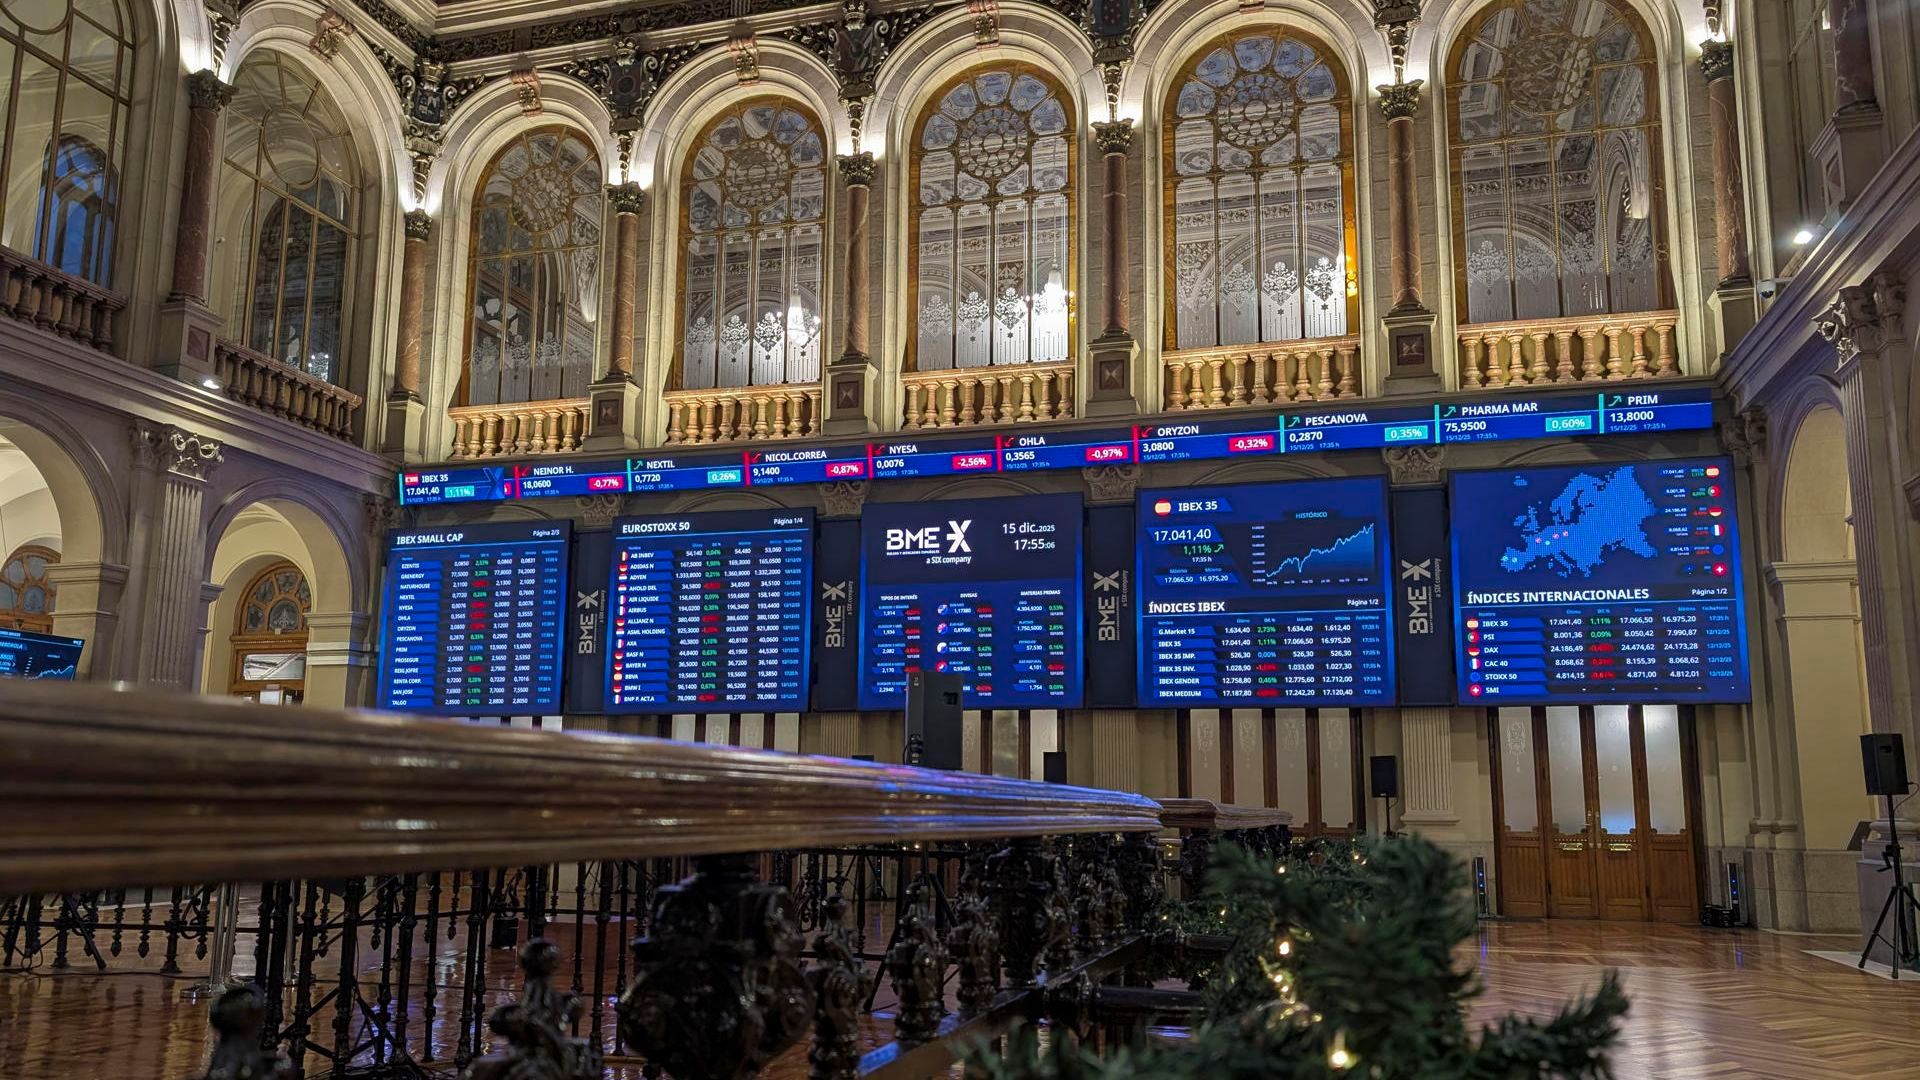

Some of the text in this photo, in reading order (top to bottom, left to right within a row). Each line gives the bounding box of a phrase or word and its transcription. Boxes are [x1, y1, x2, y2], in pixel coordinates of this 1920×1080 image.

[1628, 395, 1658, 405] PRIM
[1462, 403, 1537, 416] PHARMA MAR
[1305, 414, 1367, 426] PESCANOVA
[1610, 411, 1654, 422] 13,8000
[1157, 425, 1199, 436] ORYZON
[1445, 419, 1585, 433] 75,9500 0,60%
[1289, 429, 1422, 442] 0,2870 0,35%
[1019, 437, 1045, 446] OHLA
[1143, 439, 1268, 452] 3,0800 -0,32%
[889, 445, 918, 454] NYESA
[1006, 449, 1122, 461] 0,3565 -0,97%
[765, 451, 827, 462] NICOL.CORREA
[647, 460, 675, 469] NEXTIL
[876, 457, 987, 469] 0,0076 -2,56%
[533, 466, 574, 476] NEINOR H.
[753, 465, 858, 476] 9,1400 -0,87%
[422, 474, 448, 483] IBEX 35
[635, 473, 736, 482] 0,7720 0,26%
[523, 479, 619, 488] 18,0600 -0,77%
[406, 488, 439, 496] 17.041,40
[1179, 501, 1217, 511] IBEX 35
[1296, 511, 1328, 519] HISTÓRICO
[622, 522, 690, 533] EUROSTOXX 50
[1003, 523, 1055, 534] 15 dic.2025
[397, 534, 463, 544] IBEX SMALL CAP
[887, 527, 940, 550] BME
[1154, 529, 1212, 541] 17.041,40
[1014, 539, 1055, 550] 17:55:06
[1184, 545, 1212, 555] 1,11%
[943, 555, 971, 564] company
[1164, 576, 1193, 584] 17.066,50
[1467, 589, 1649, 604] ÍNDICES INTERNACIONALES
[1692, 587, 1727, 597] Página 1/2
[1149, 601, 1224, 614] ÍNDICES IBEX
[1408, 586, 1428, 634] BME
[1098, 596, 1115, 641] BME
[1620, 617, 1653, 625] 17.066,50
[1662, 615, 1696, 623] 16.975,20
[825, 605, 841, 647] BME
[1158, 628, 1185, 636] G.Market
[1324, 624, 1351, 632] 1.612,40
[578, 613, 594, 653] BME
[1624, 630, 1654, 638] 8.050,42
[1667, 629, 1697, 637] 7.990,87
[1550, 645, 1583, 653] 24.186,49
[1621, 643, 1655, 651] 24.474,62
[1664, 642, 1698, 650] 24.173,28
[1230, 651, 1251, 659] 526,30
[1555, 658, 1584, 666] 8.068,62
[1626, 657, 1656, 665] 8.155,39
[1669, 656, 1699, 664] 8.068,62
[1627, 670, 1656, 678] 4.871,00
[1670, 670, 1700, 678] 4.812,01
